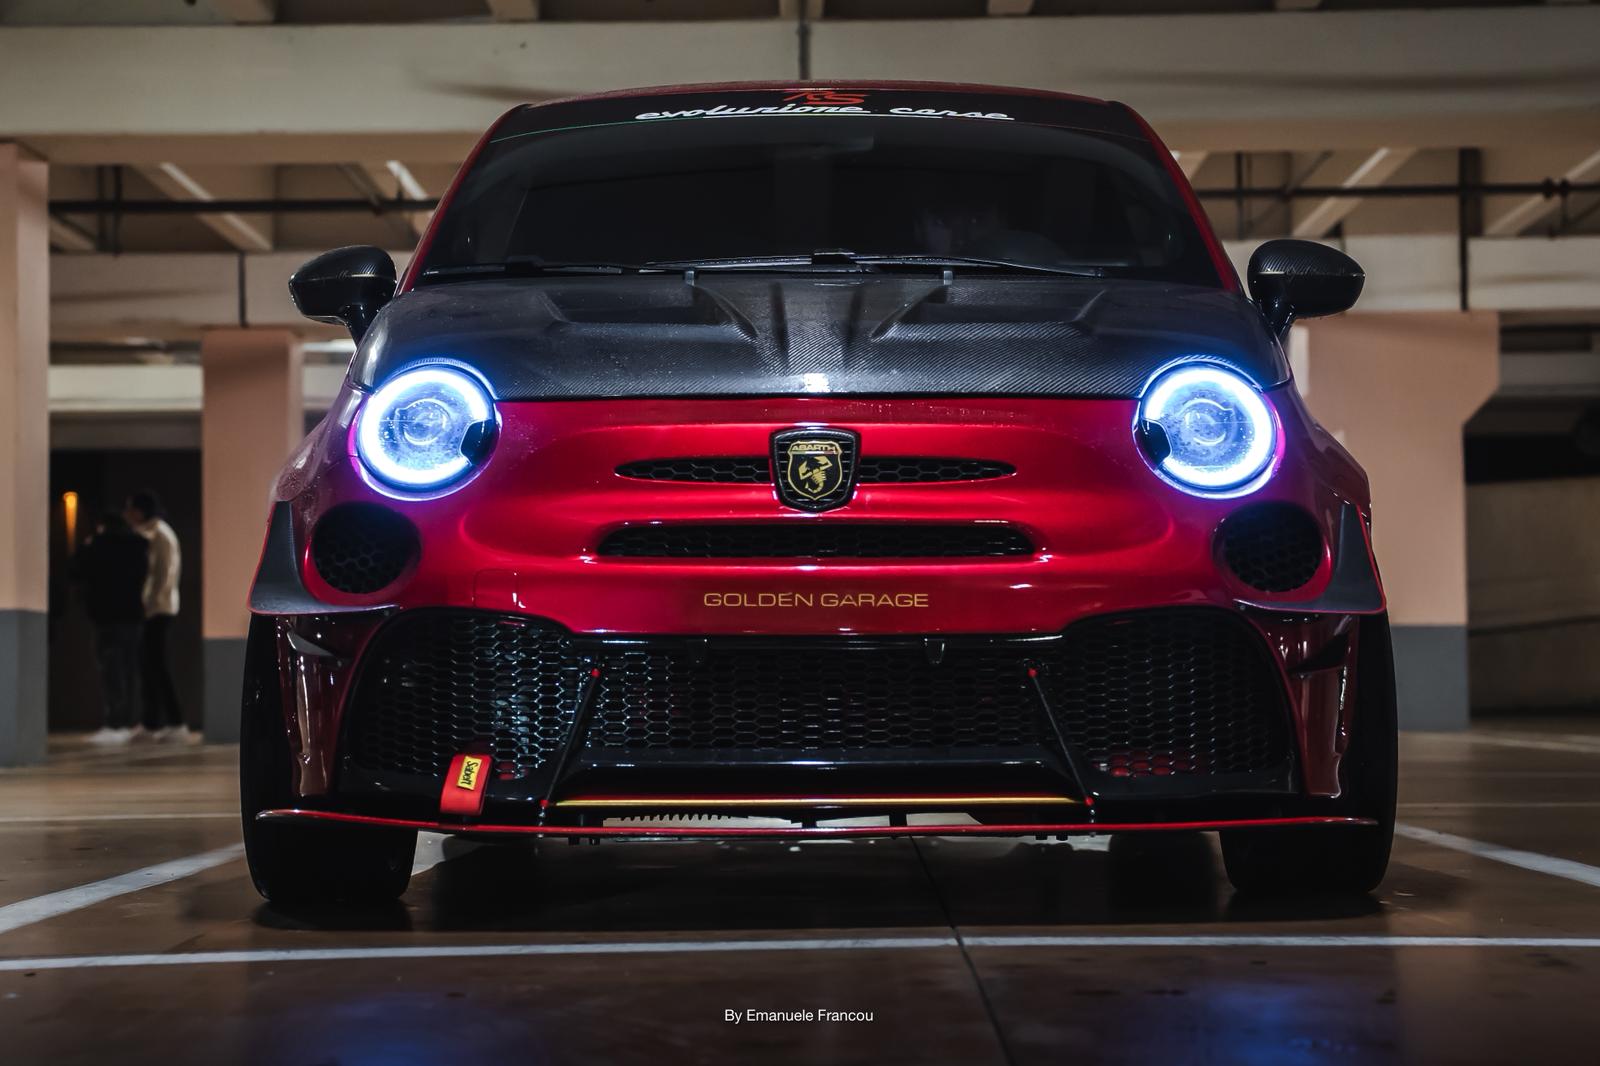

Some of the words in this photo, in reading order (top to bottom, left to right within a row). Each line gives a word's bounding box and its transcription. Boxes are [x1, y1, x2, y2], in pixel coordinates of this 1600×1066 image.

[791, 444, 836, 452] ABARTH
[704, 593, 813, 607] GOLDEN
[820, 593, 929, 607] GARAGE
